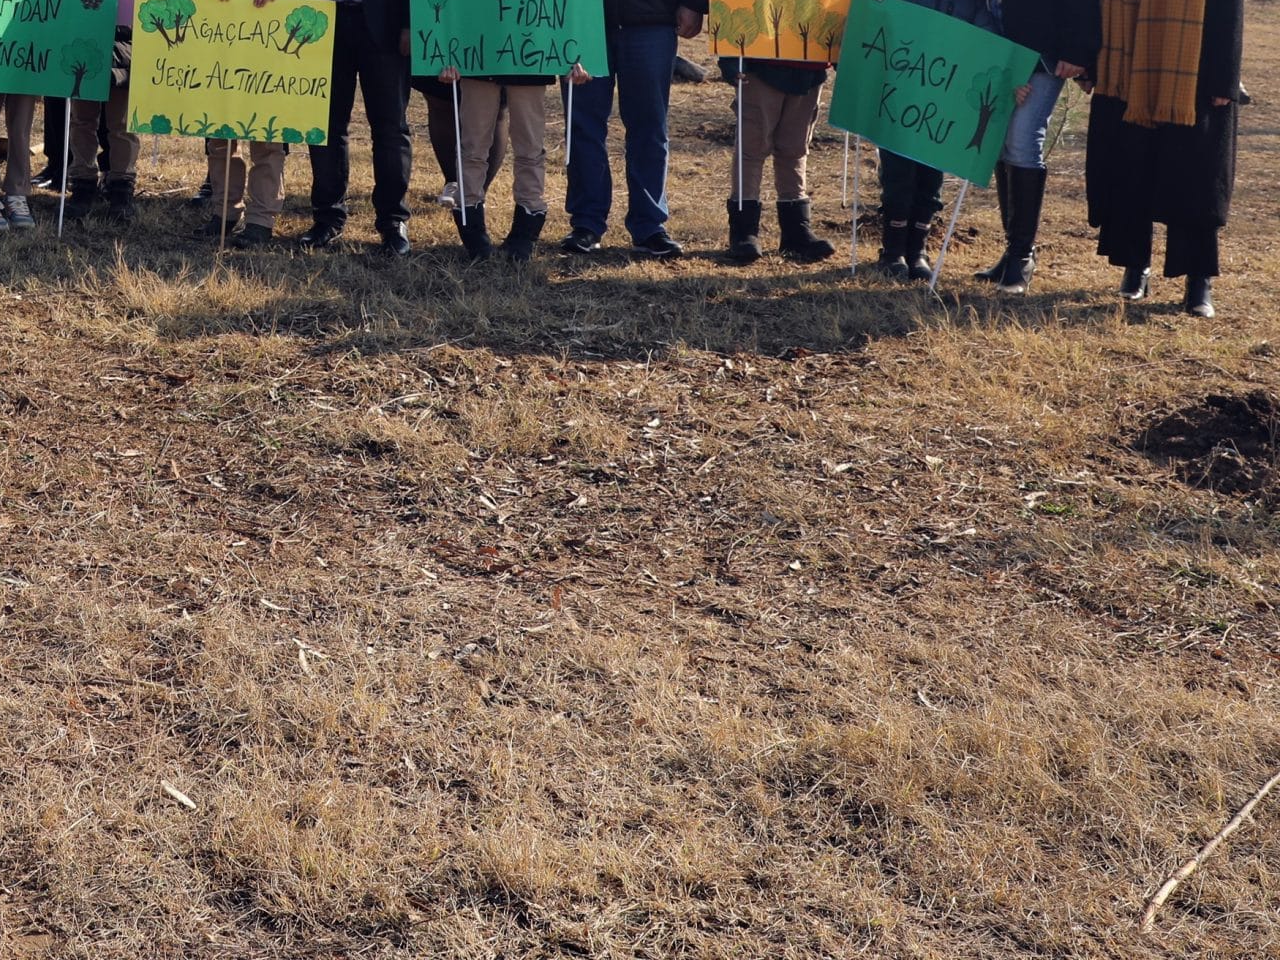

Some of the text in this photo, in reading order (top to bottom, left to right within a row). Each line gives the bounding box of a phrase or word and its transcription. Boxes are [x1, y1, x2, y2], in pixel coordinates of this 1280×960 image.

[180, 15, 280, 50] AĞAÇLAR
[418, 30, 484, 71] YARIN
[152, 58, 201, 94] YEŞİL
[862, 26, 958, 92] AĞACI
[878, 83, 955, 144] KORU
